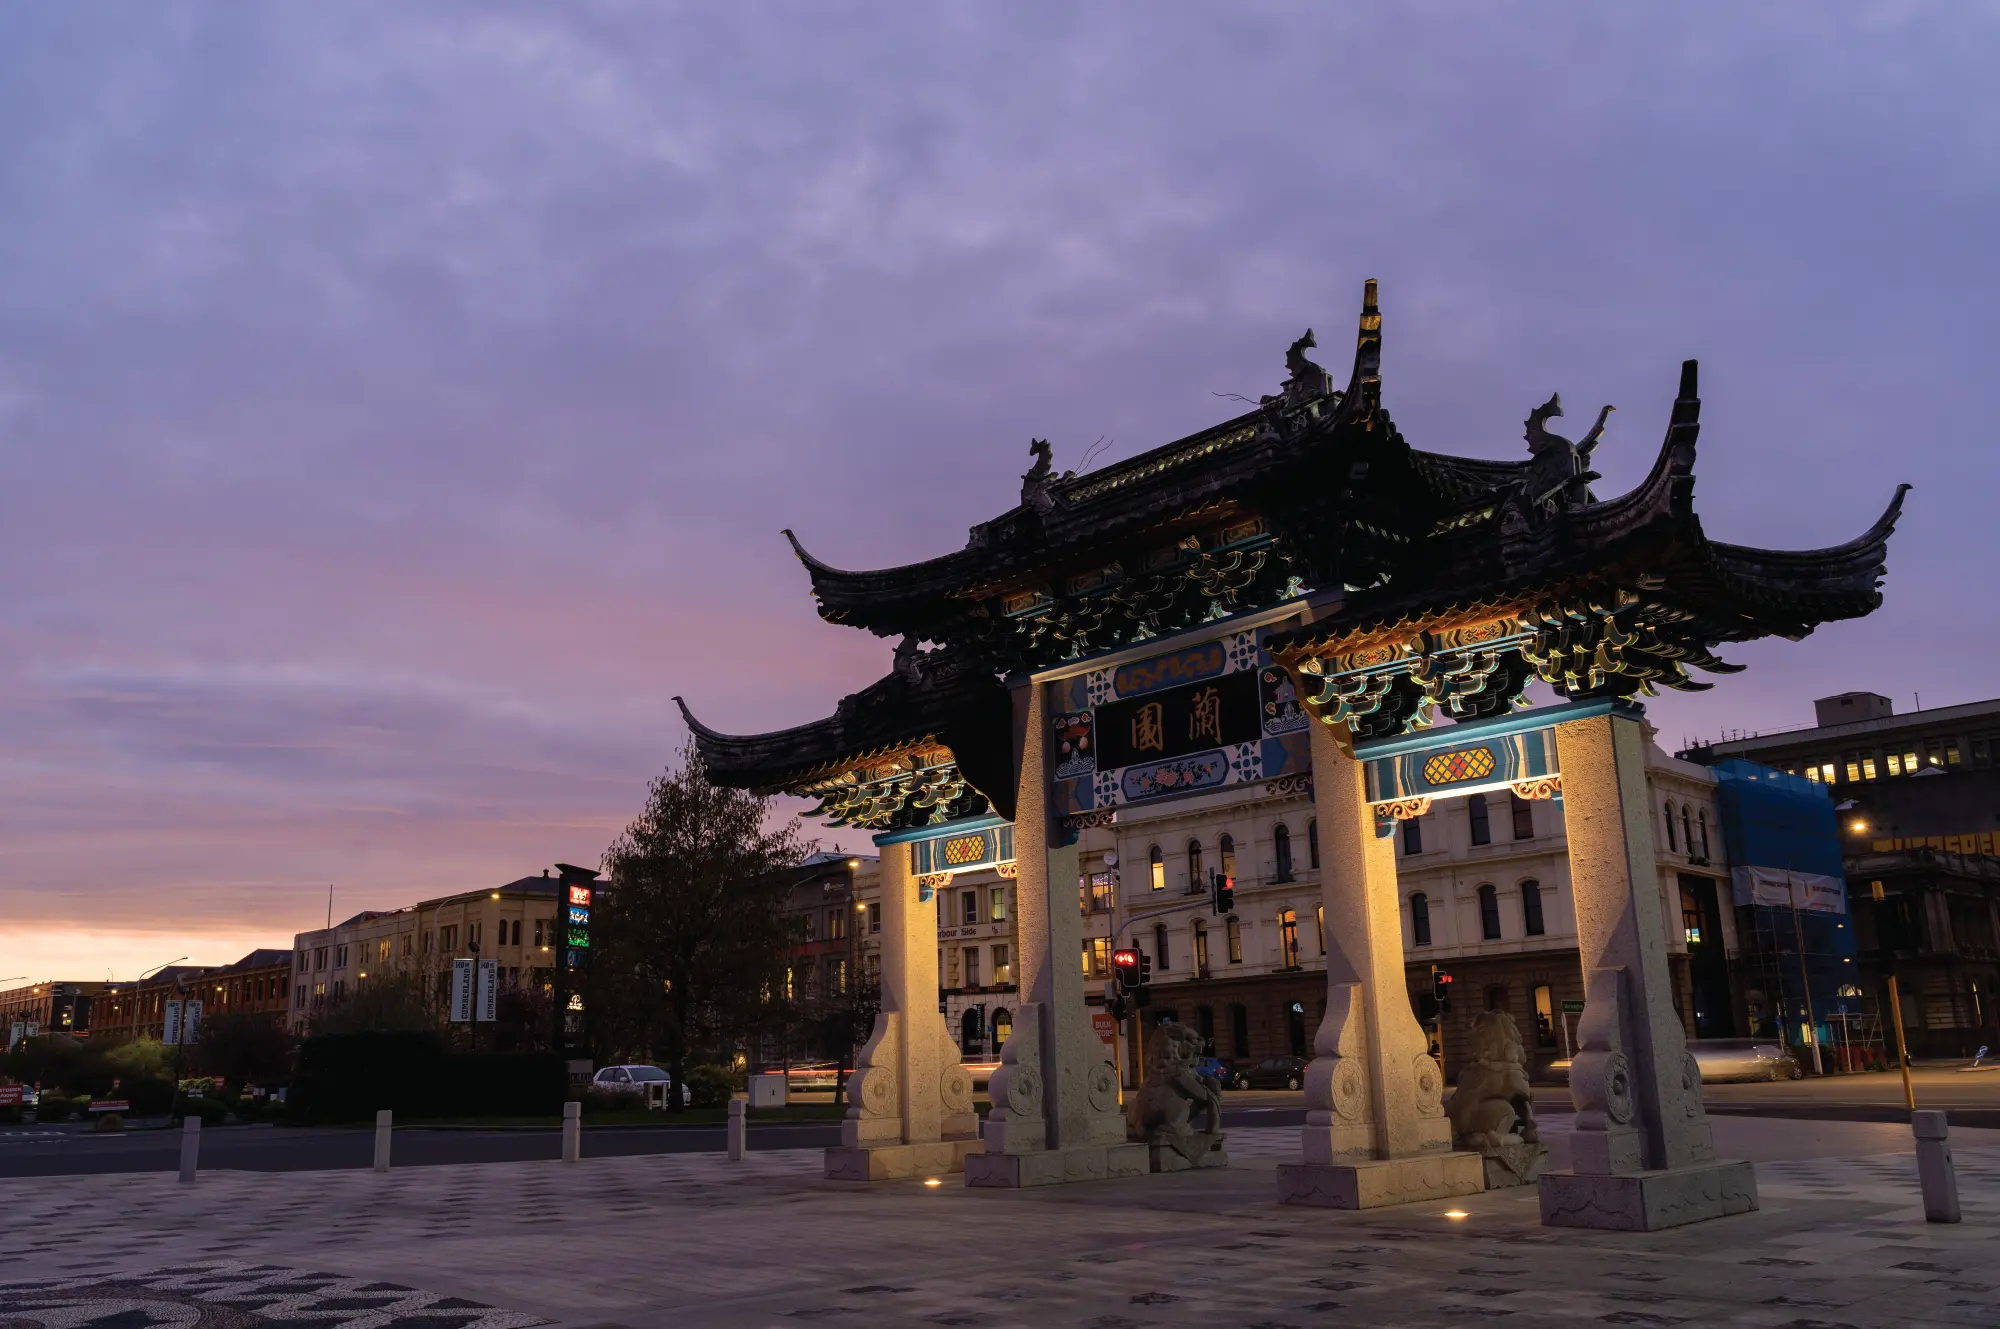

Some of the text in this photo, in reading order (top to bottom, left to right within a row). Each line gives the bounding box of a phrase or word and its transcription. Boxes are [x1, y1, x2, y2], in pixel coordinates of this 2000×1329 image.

[961, 927, 977, 936] Side
[461, 968, 471, 1019] CUMBERLAND
[487, 968, 496, 1019] CUMBERLAND
[1095, 1020, 1112, 1029] BULK
